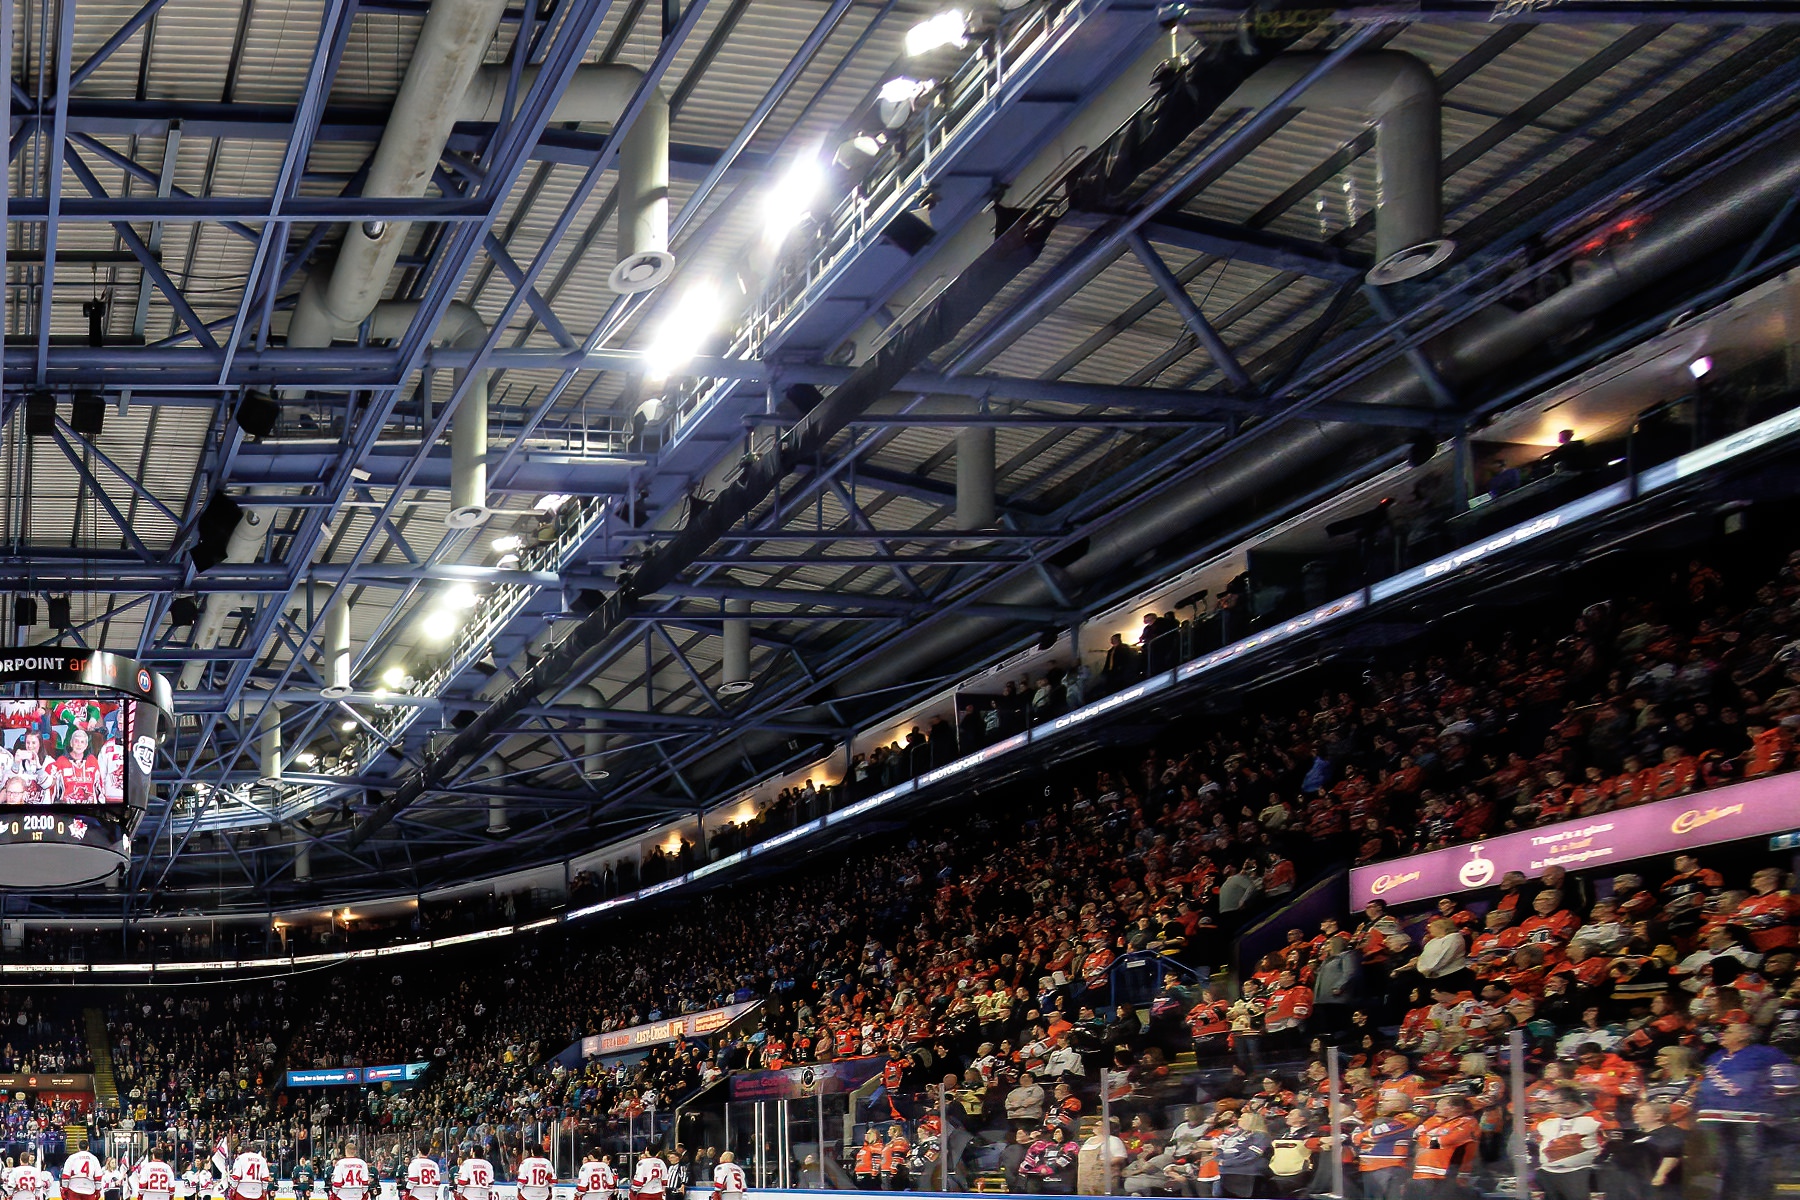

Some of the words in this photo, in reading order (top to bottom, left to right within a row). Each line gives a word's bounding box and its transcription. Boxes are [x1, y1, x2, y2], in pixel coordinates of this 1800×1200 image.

[11, 822, 19, 835] 0
[23, 815, 54, 830] 20:00
[57, 821, 65, 835] 0
[81, 1161, 89, 1177] 4
[246, 1163, 260, 1180] 41
[533, 1169, 546, 1185] 18
[19, 1176, 36, 1192] 63
[150, 1174, 168, 1190] 22
[346, 1170, 362, 1186] 44
[473, 1171, 487, 1186] 16
[733, 1173, 742, 1190] 5
